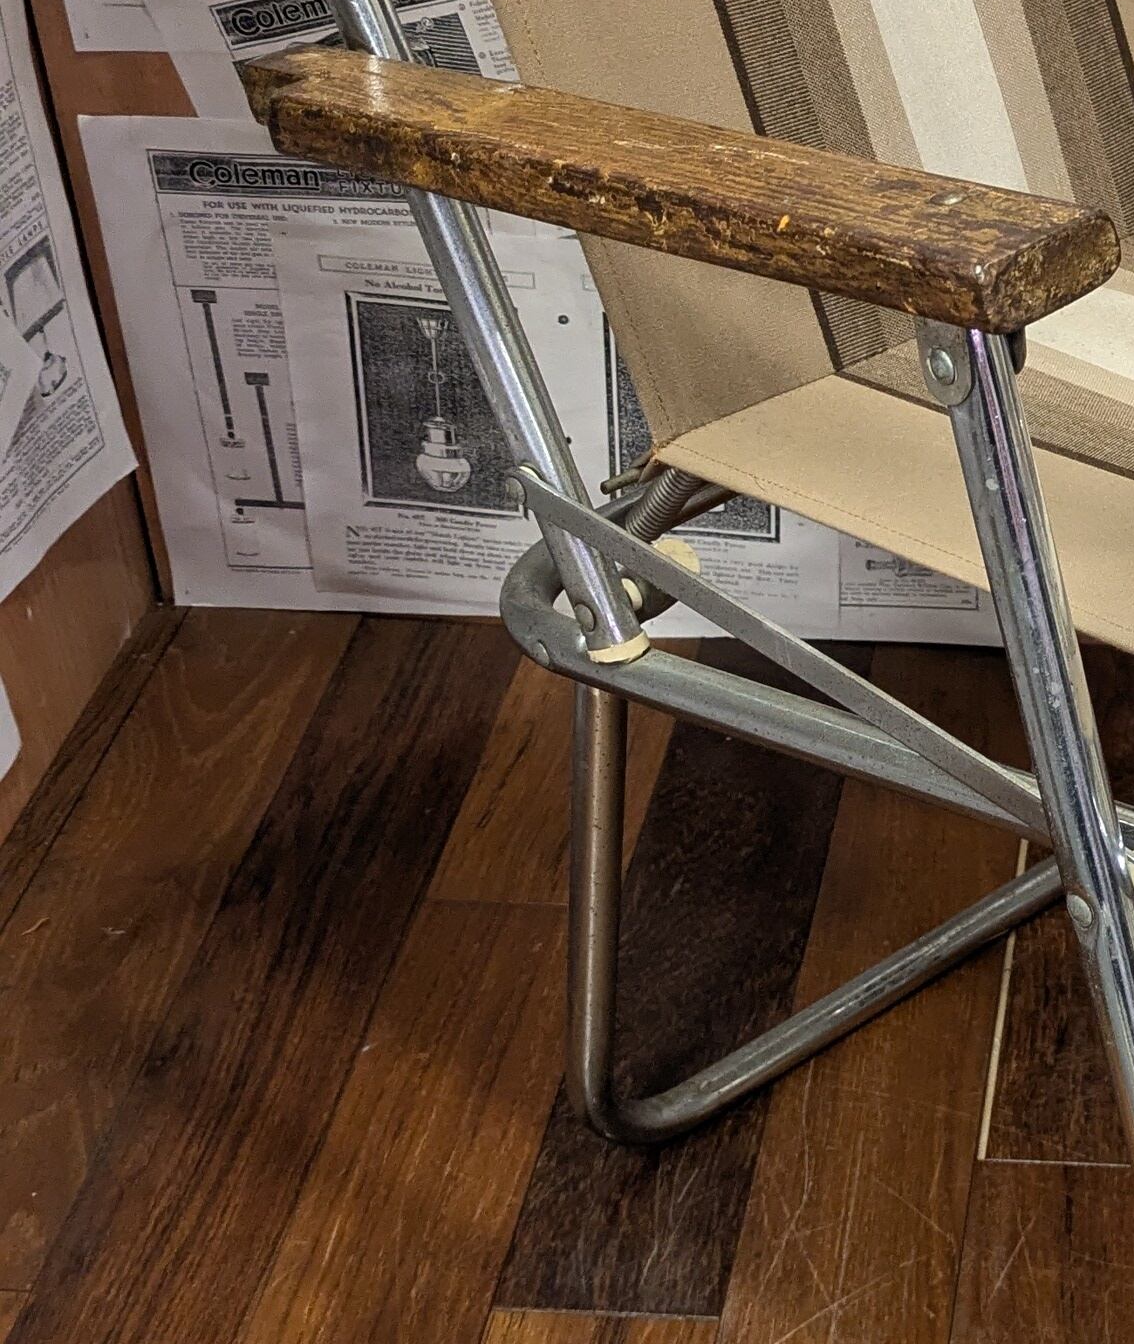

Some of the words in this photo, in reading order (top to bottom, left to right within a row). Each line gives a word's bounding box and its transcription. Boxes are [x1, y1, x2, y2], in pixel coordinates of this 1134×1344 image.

[187, 159, 320, 193] Coleman
[337, 178, 403, 197] FIXTU
[202, 200, 224, 209] FOR
[227, 201, 247, 210] USE
[251, 203, 278, 211] WITH
[282, 204, 335, 214] LIQUEFIED
[338, 206, 409, 217] HYDROCARBO
[344, 261, 399, 272] COLEMAN
[364, 279, 381, 288] No
[384, 281, 423, 292] Alcohol
